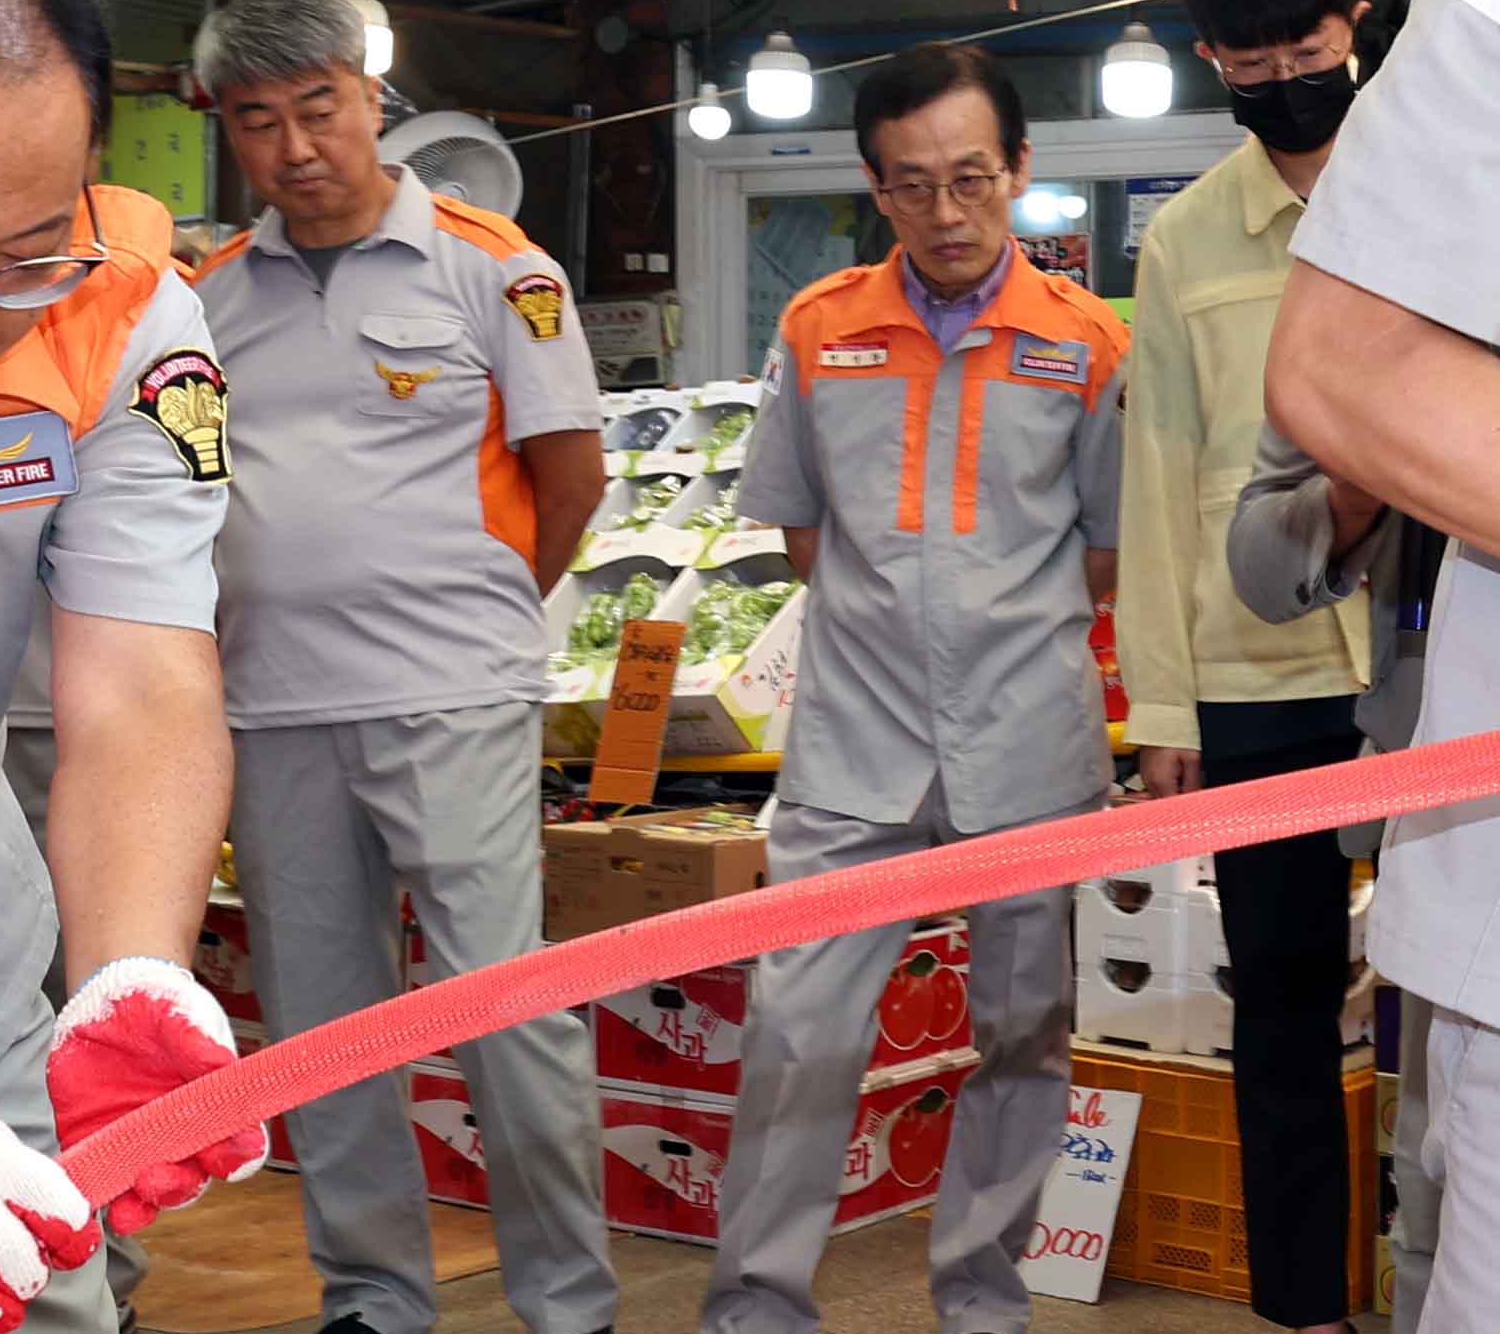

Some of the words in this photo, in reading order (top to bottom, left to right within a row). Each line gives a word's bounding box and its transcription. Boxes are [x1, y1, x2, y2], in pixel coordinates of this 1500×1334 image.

[16, 463, 49, 485] FIRE
[658, 1010, 709, 1072] 사과
[668, 1158, 718, 1219] 사과
